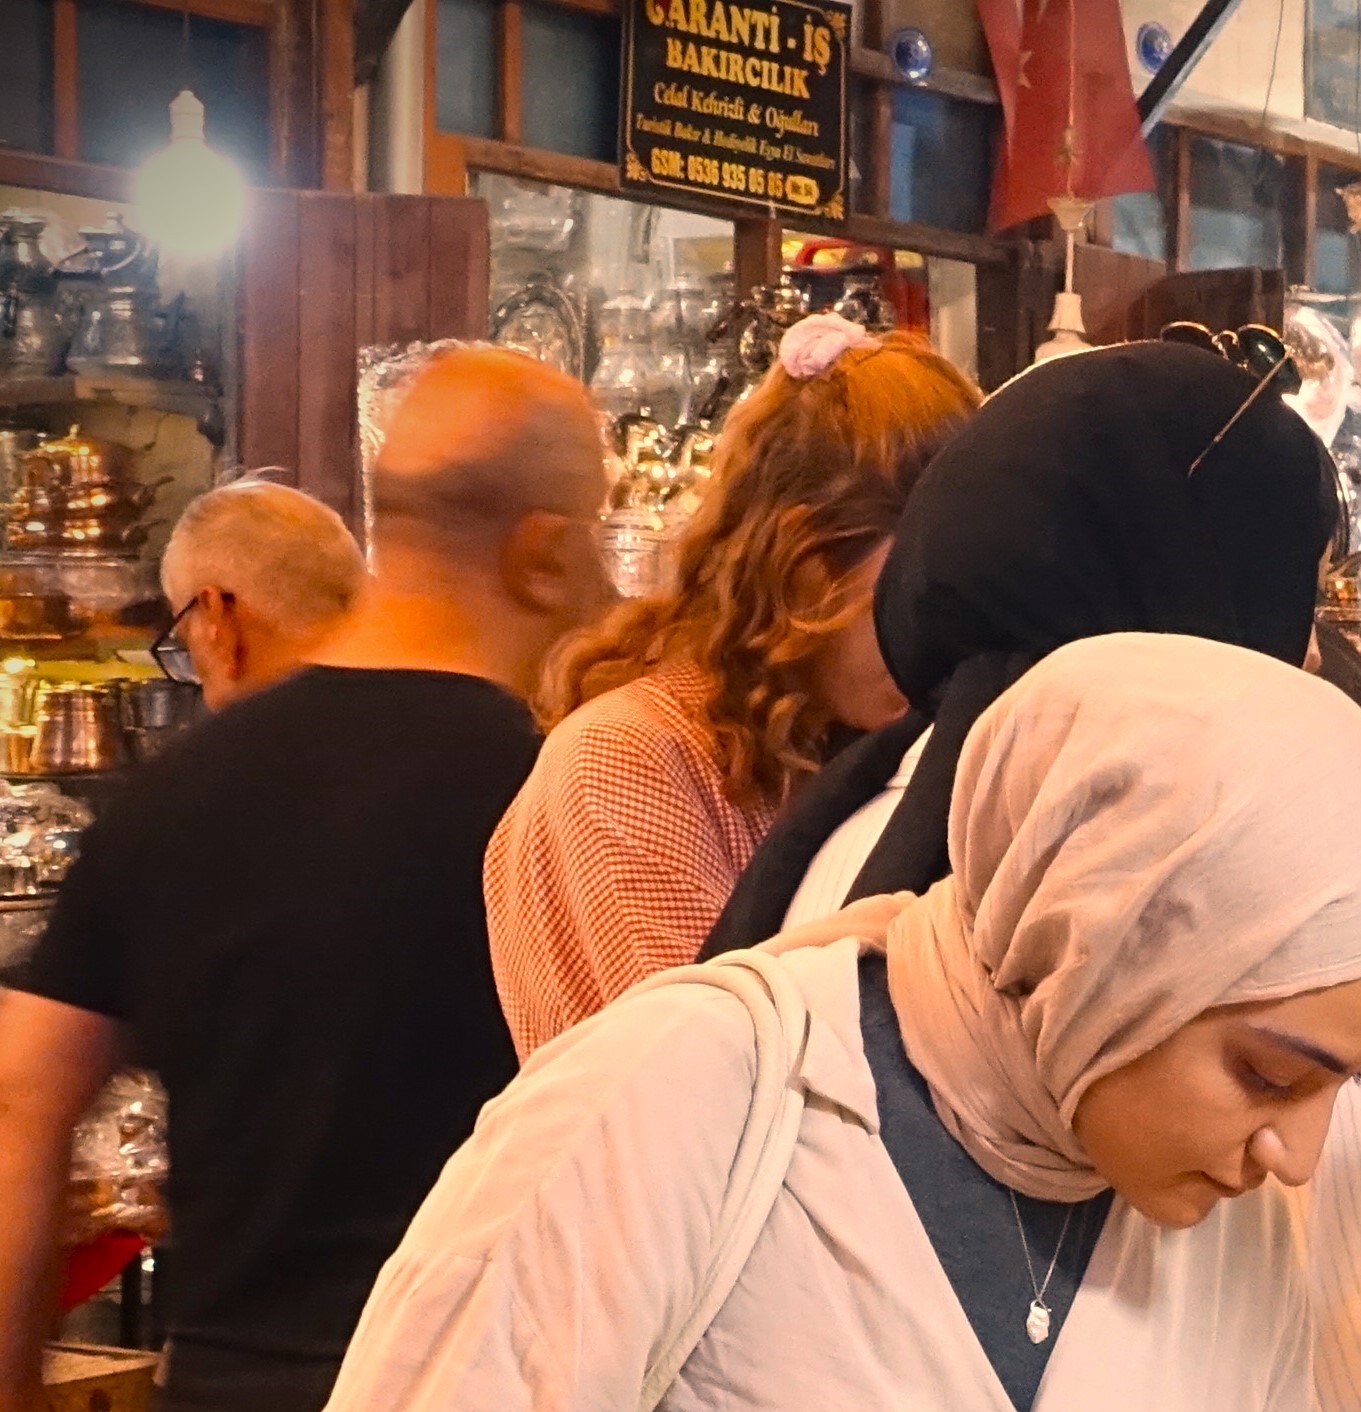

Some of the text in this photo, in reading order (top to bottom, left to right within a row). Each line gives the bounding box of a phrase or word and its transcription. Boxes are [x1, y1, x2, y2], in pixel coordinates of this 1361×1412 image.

[666, 36, 811, 99] BAKIRCILIK
[802, 14, 831, 76] İŞ
[748, 103, 763, 125] &
[651, 147, 685, 179] GSM:
[688, 155, 719, 186] 0536
[722, 161, 747, 191] 935
